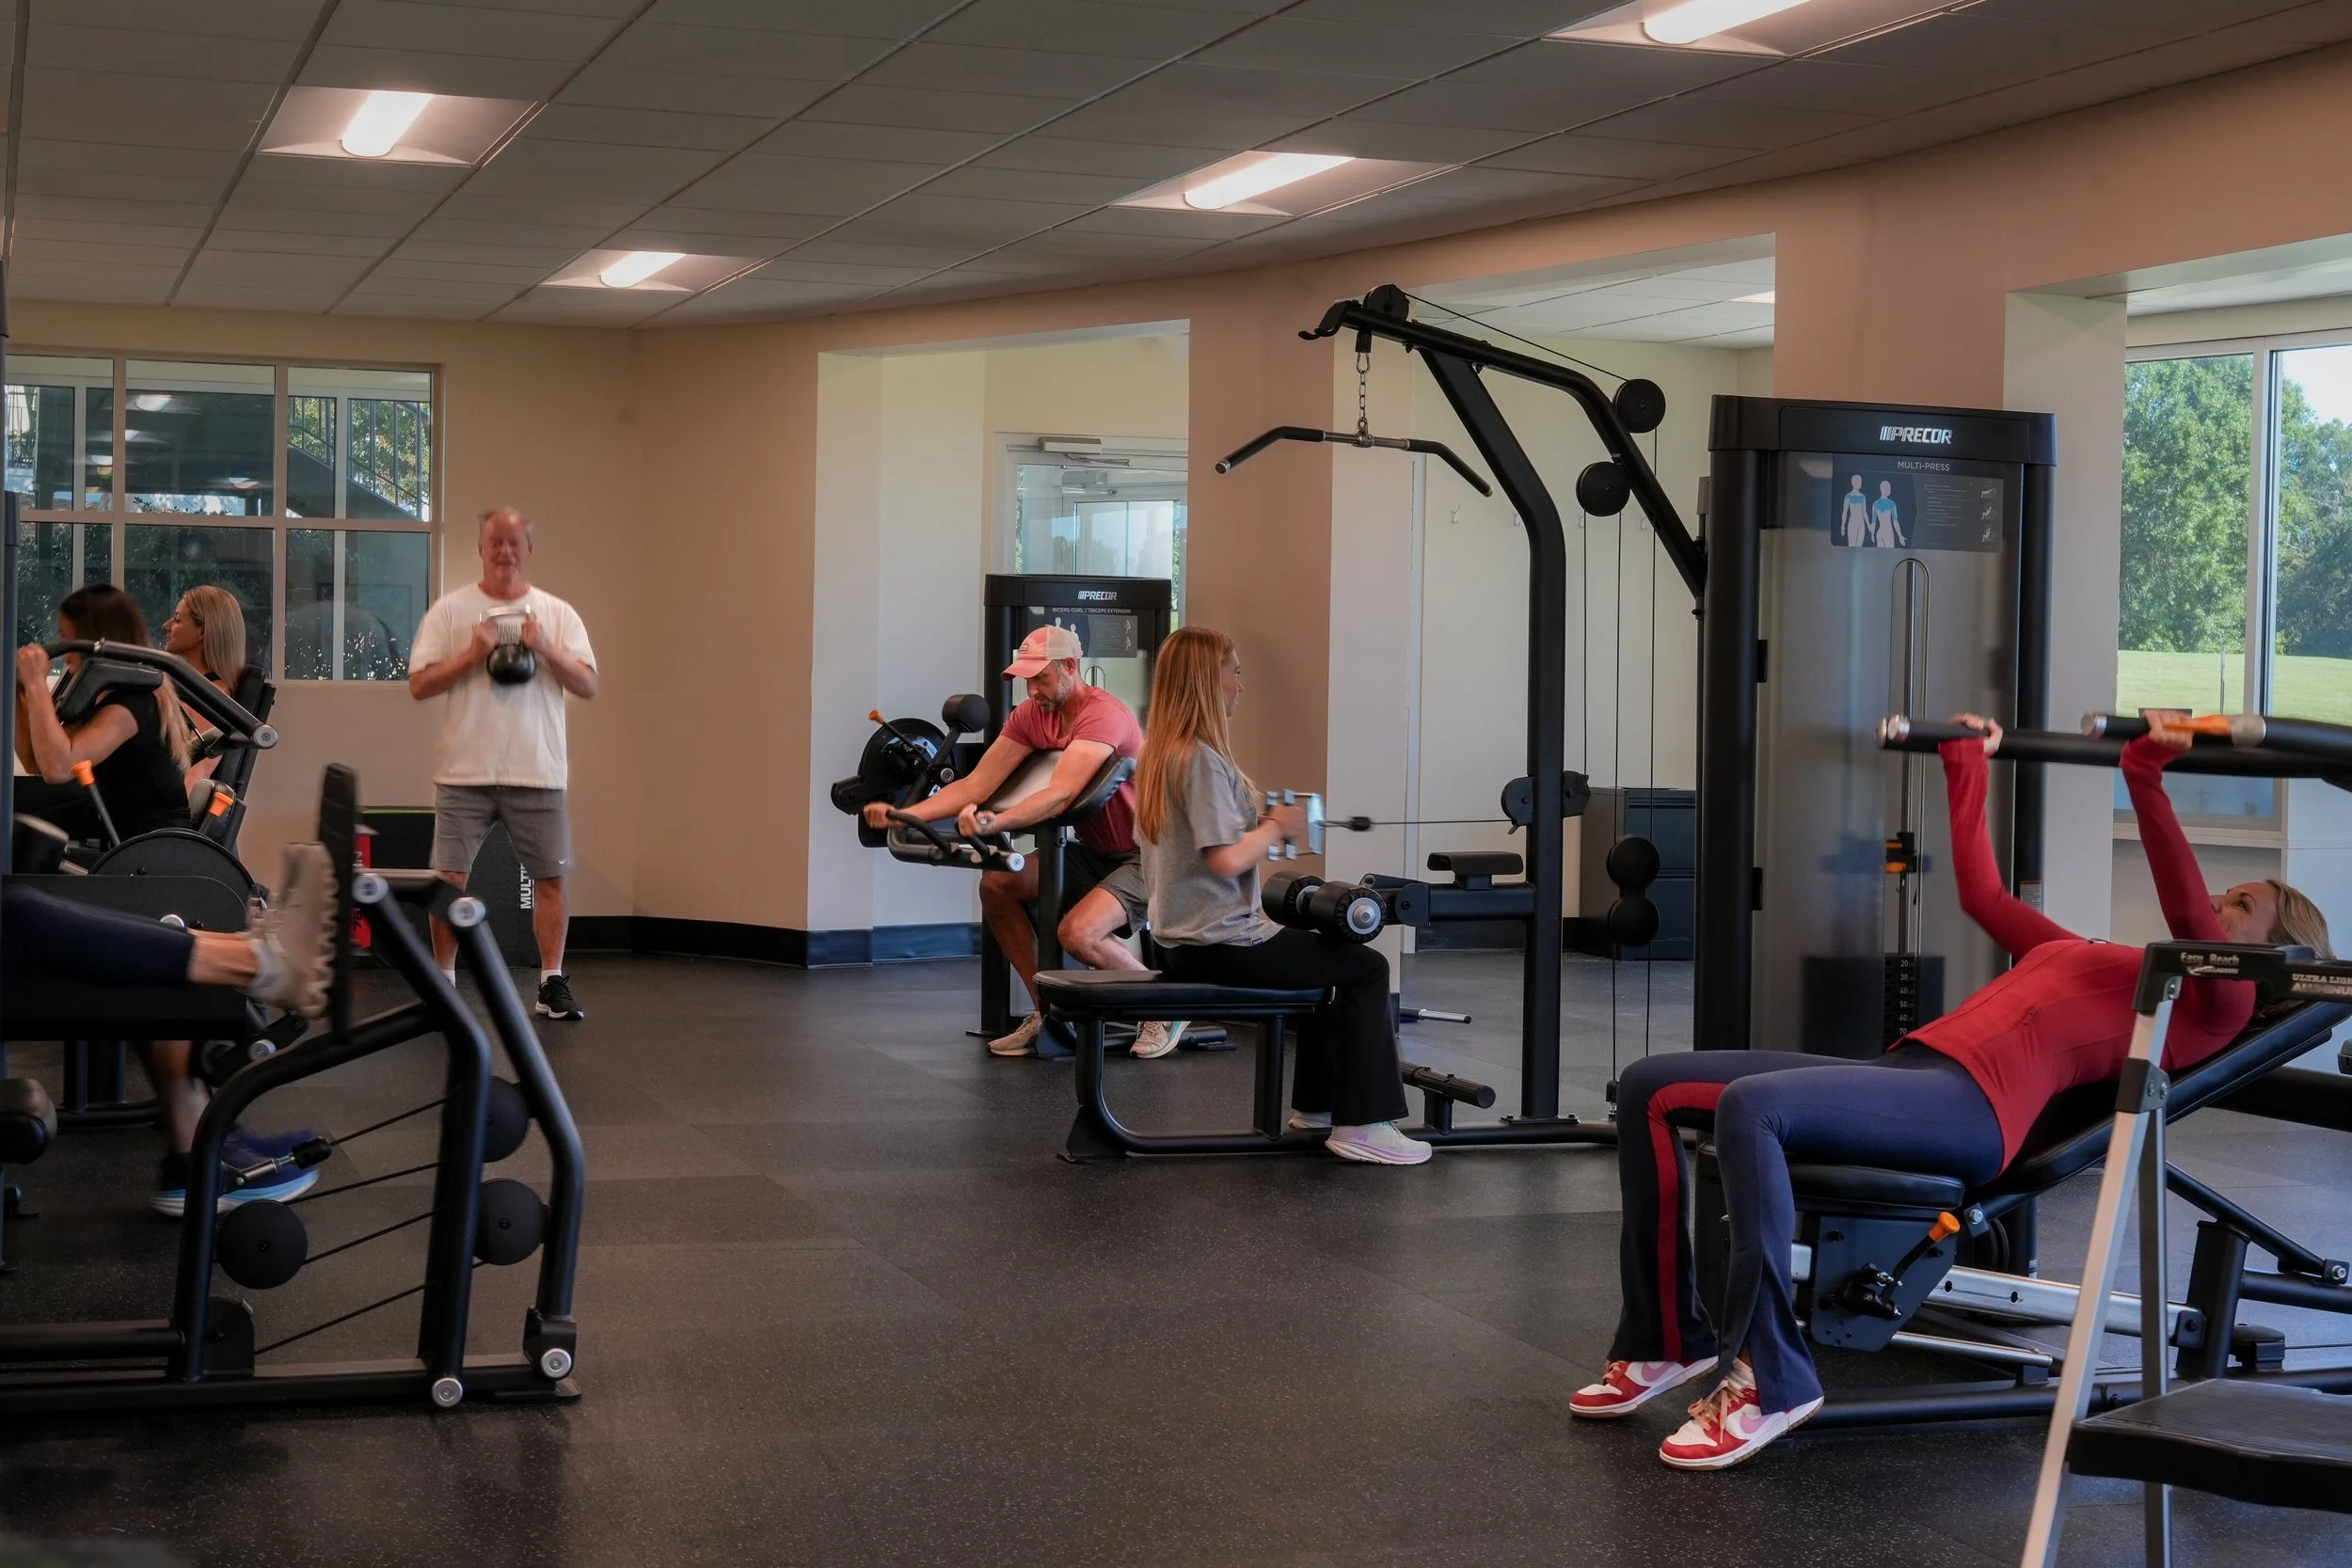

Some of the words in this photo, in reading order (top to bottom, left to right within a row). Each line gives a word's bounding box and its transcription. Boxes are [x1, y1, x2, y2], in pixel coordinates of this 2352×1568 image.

[1890, 426, 1952, 444] PRECOR
[1897, 460, 1950, 471] MULTI-PRESS
[1083, 591, 1118, 600] PRECOR
[2180, 952, 2203, 964] Easy
[2209, 954, 2239, 965] Reach
[2292, 974, 2327, 983] ULTRA
